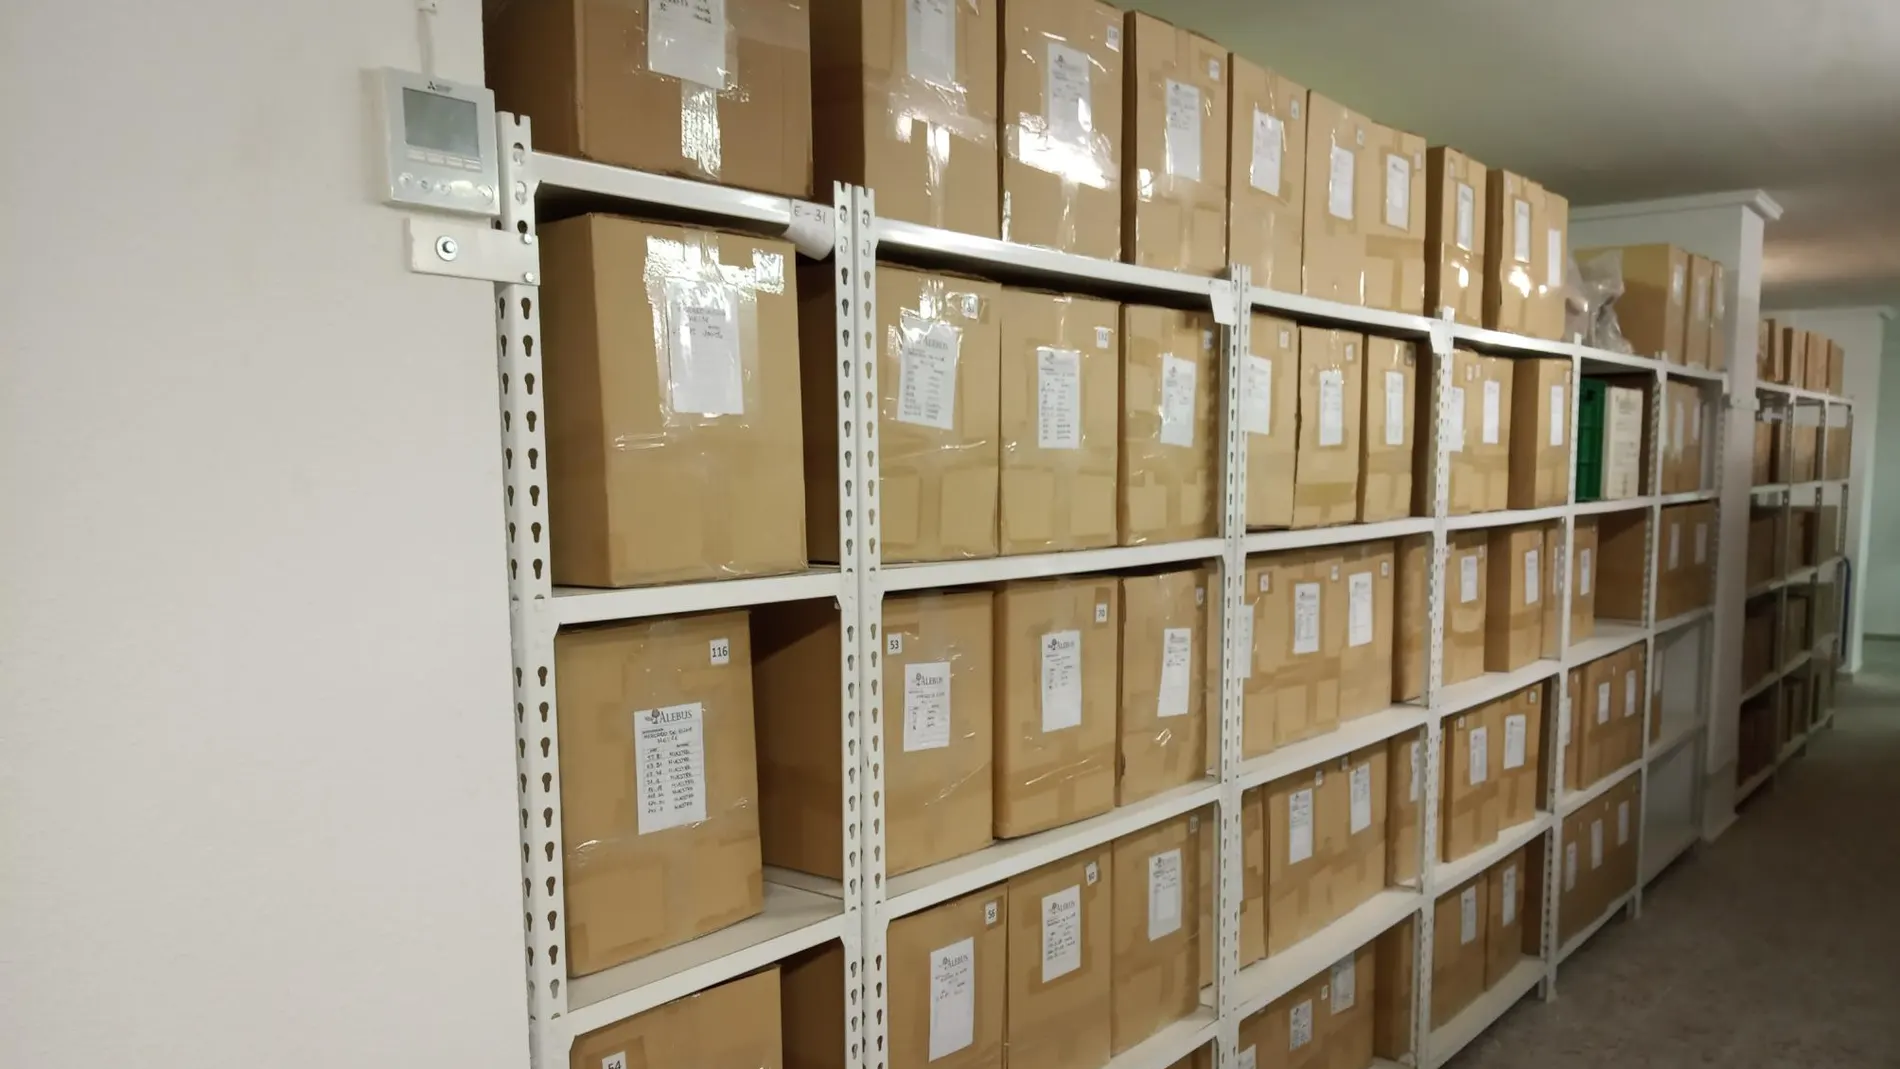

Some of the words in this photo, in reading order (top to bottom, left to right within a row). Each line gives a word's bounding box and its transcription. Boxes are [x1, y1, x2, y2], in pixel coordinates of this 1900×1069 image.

[890, 639, 899, 650] 53
[712, 646, 728, 658] 116
[659, 710, 693, 724] ALEBUS
